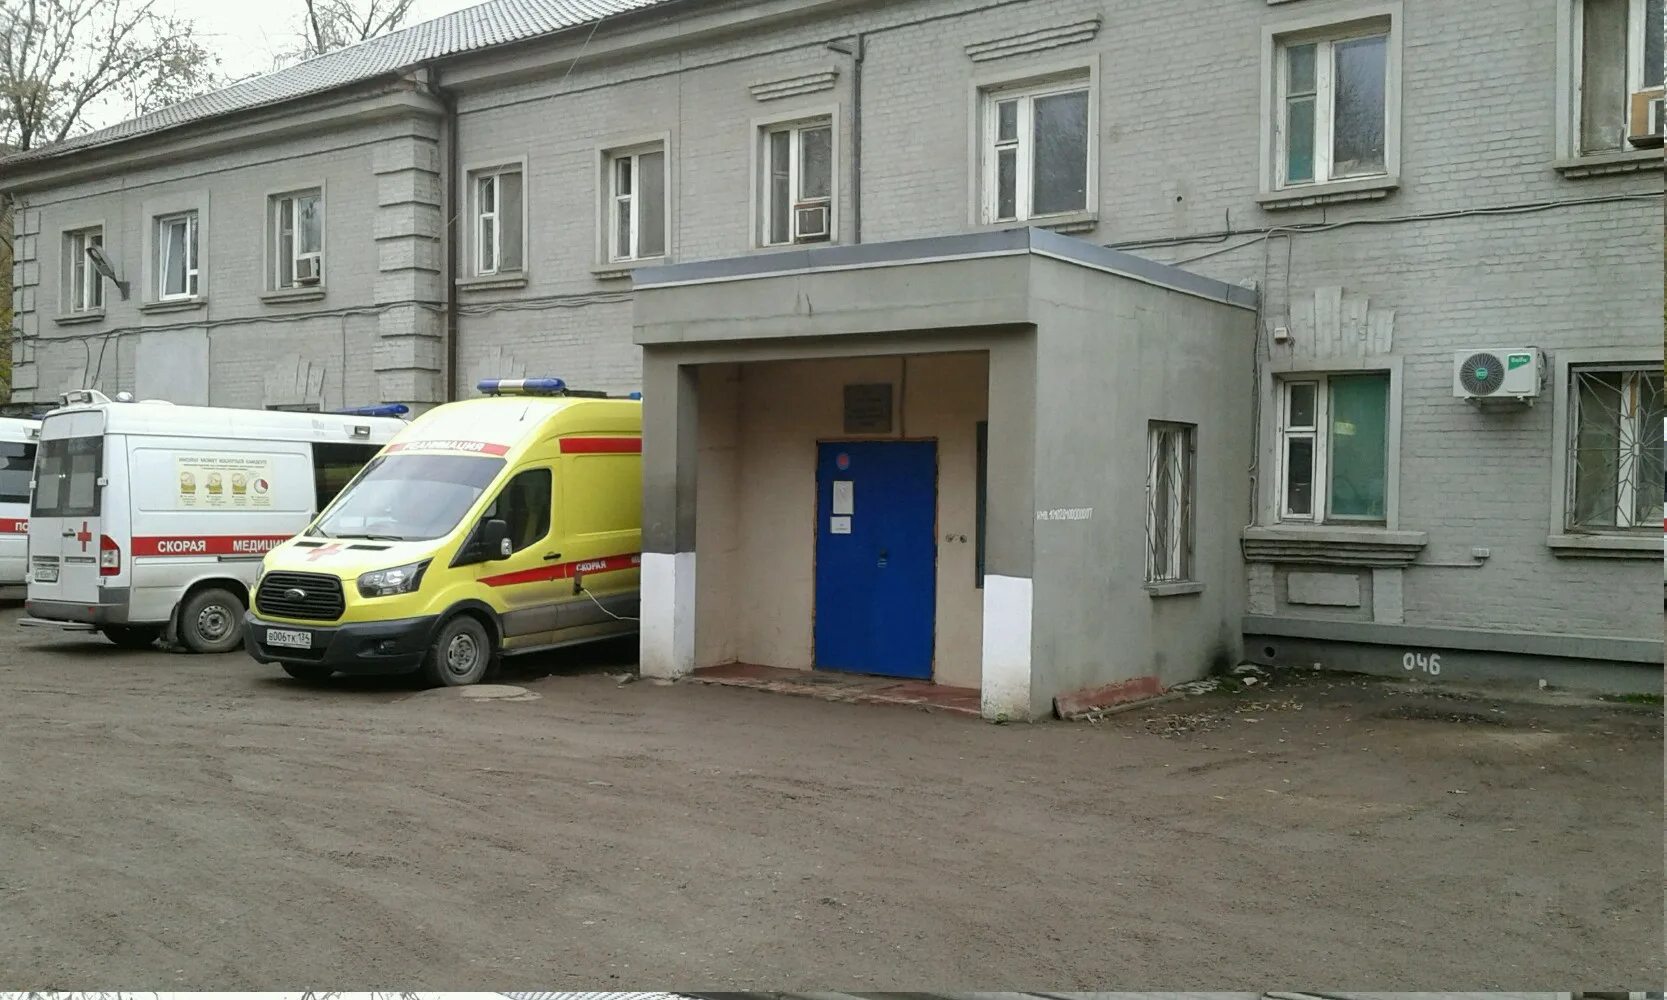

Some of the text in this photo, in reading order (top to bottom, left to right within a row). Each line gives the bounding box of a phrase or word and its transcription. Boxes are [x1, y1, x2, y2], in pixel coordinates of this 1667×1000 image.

[157, 540, 206, 552] СКОРАЯ
[576, 560, 607, 571] СКОРАЯ
[1402, 652, 1441, 675] 046
